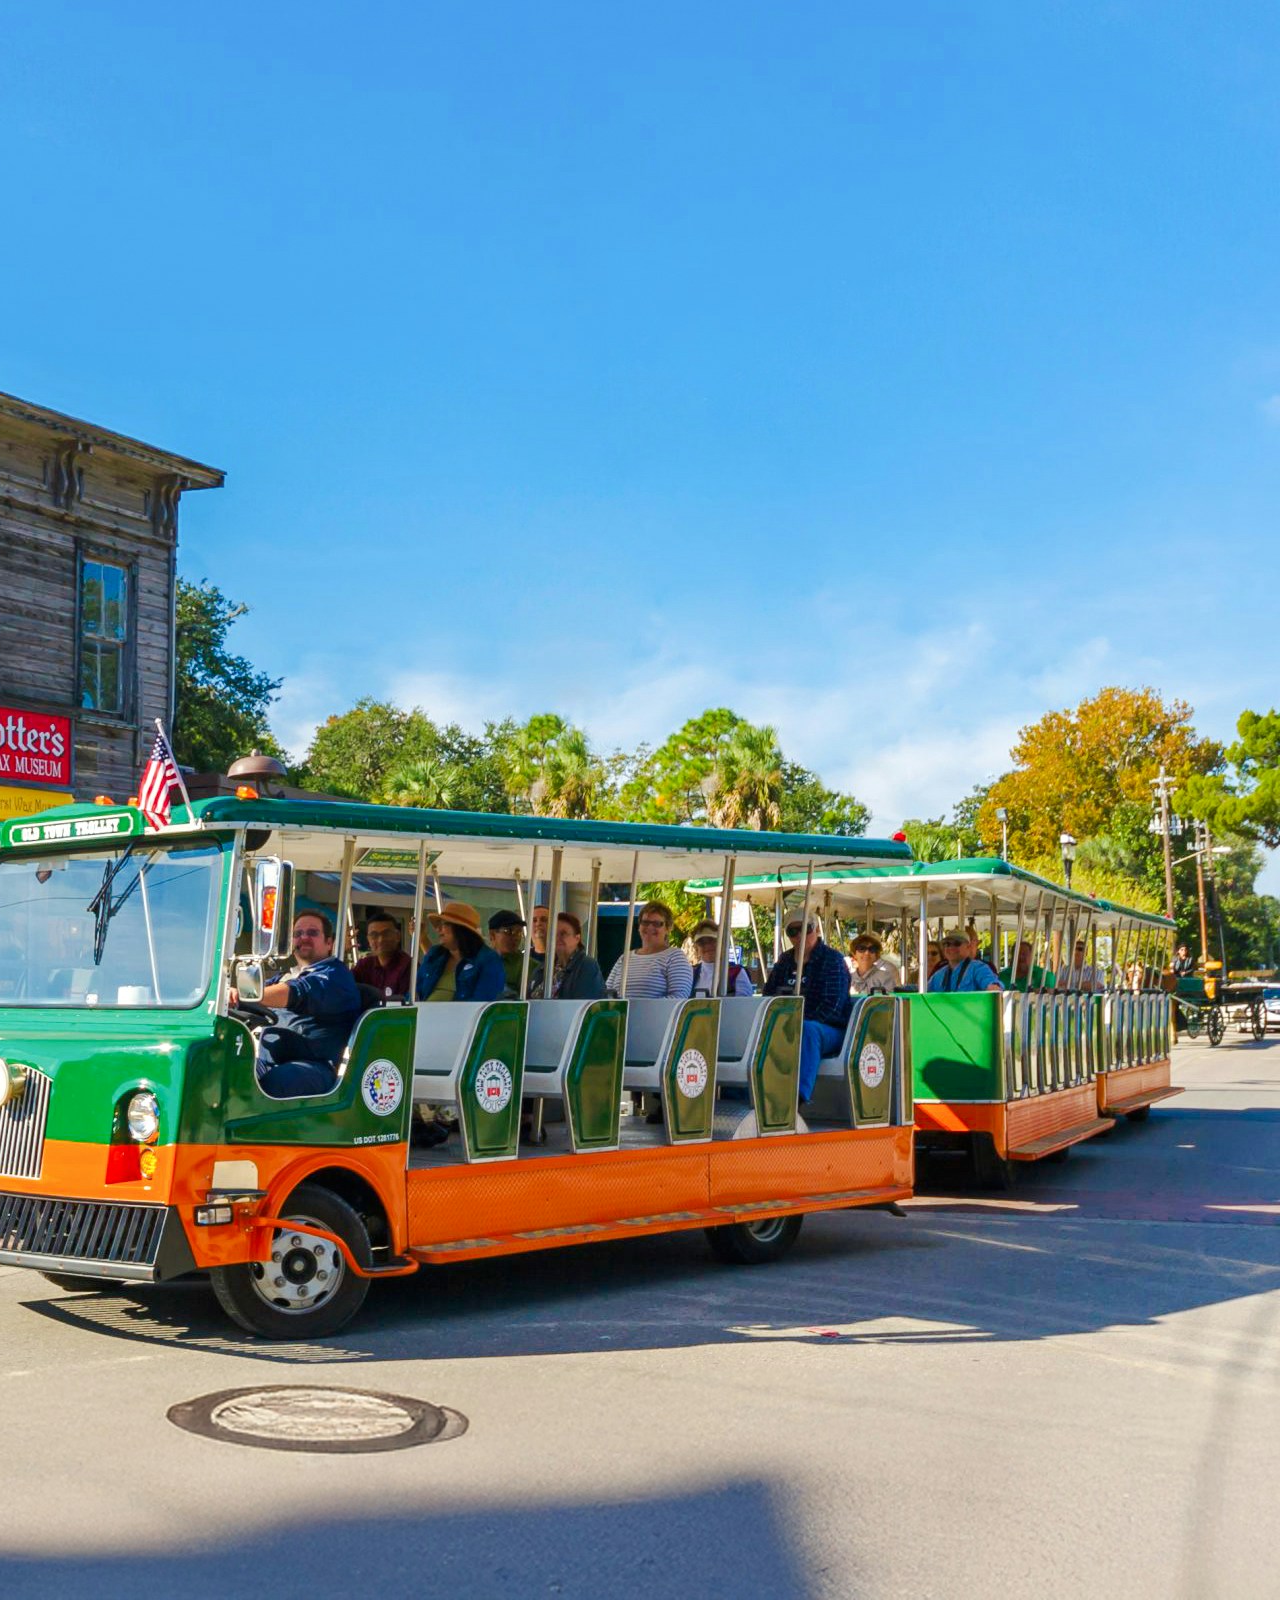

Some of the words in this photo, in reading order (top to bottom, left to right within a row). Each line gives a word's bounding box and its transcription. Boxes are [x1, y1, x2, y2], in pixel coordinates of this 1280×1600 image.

[15, 756, 62, 778] MUSEUM
[14, 797, 33, 813] Wax
[22, 827, 40, 841] OLD
[44, 823, 71, 839] TOWN
[75, 818, 120, 837] TROLLEY
[207, 1000, 216, 1015] 7
[235, 1042, 243, 1056] 7
[353, 1136, 363, 1145] US
[363, 1135, 376, 1144] DOT
